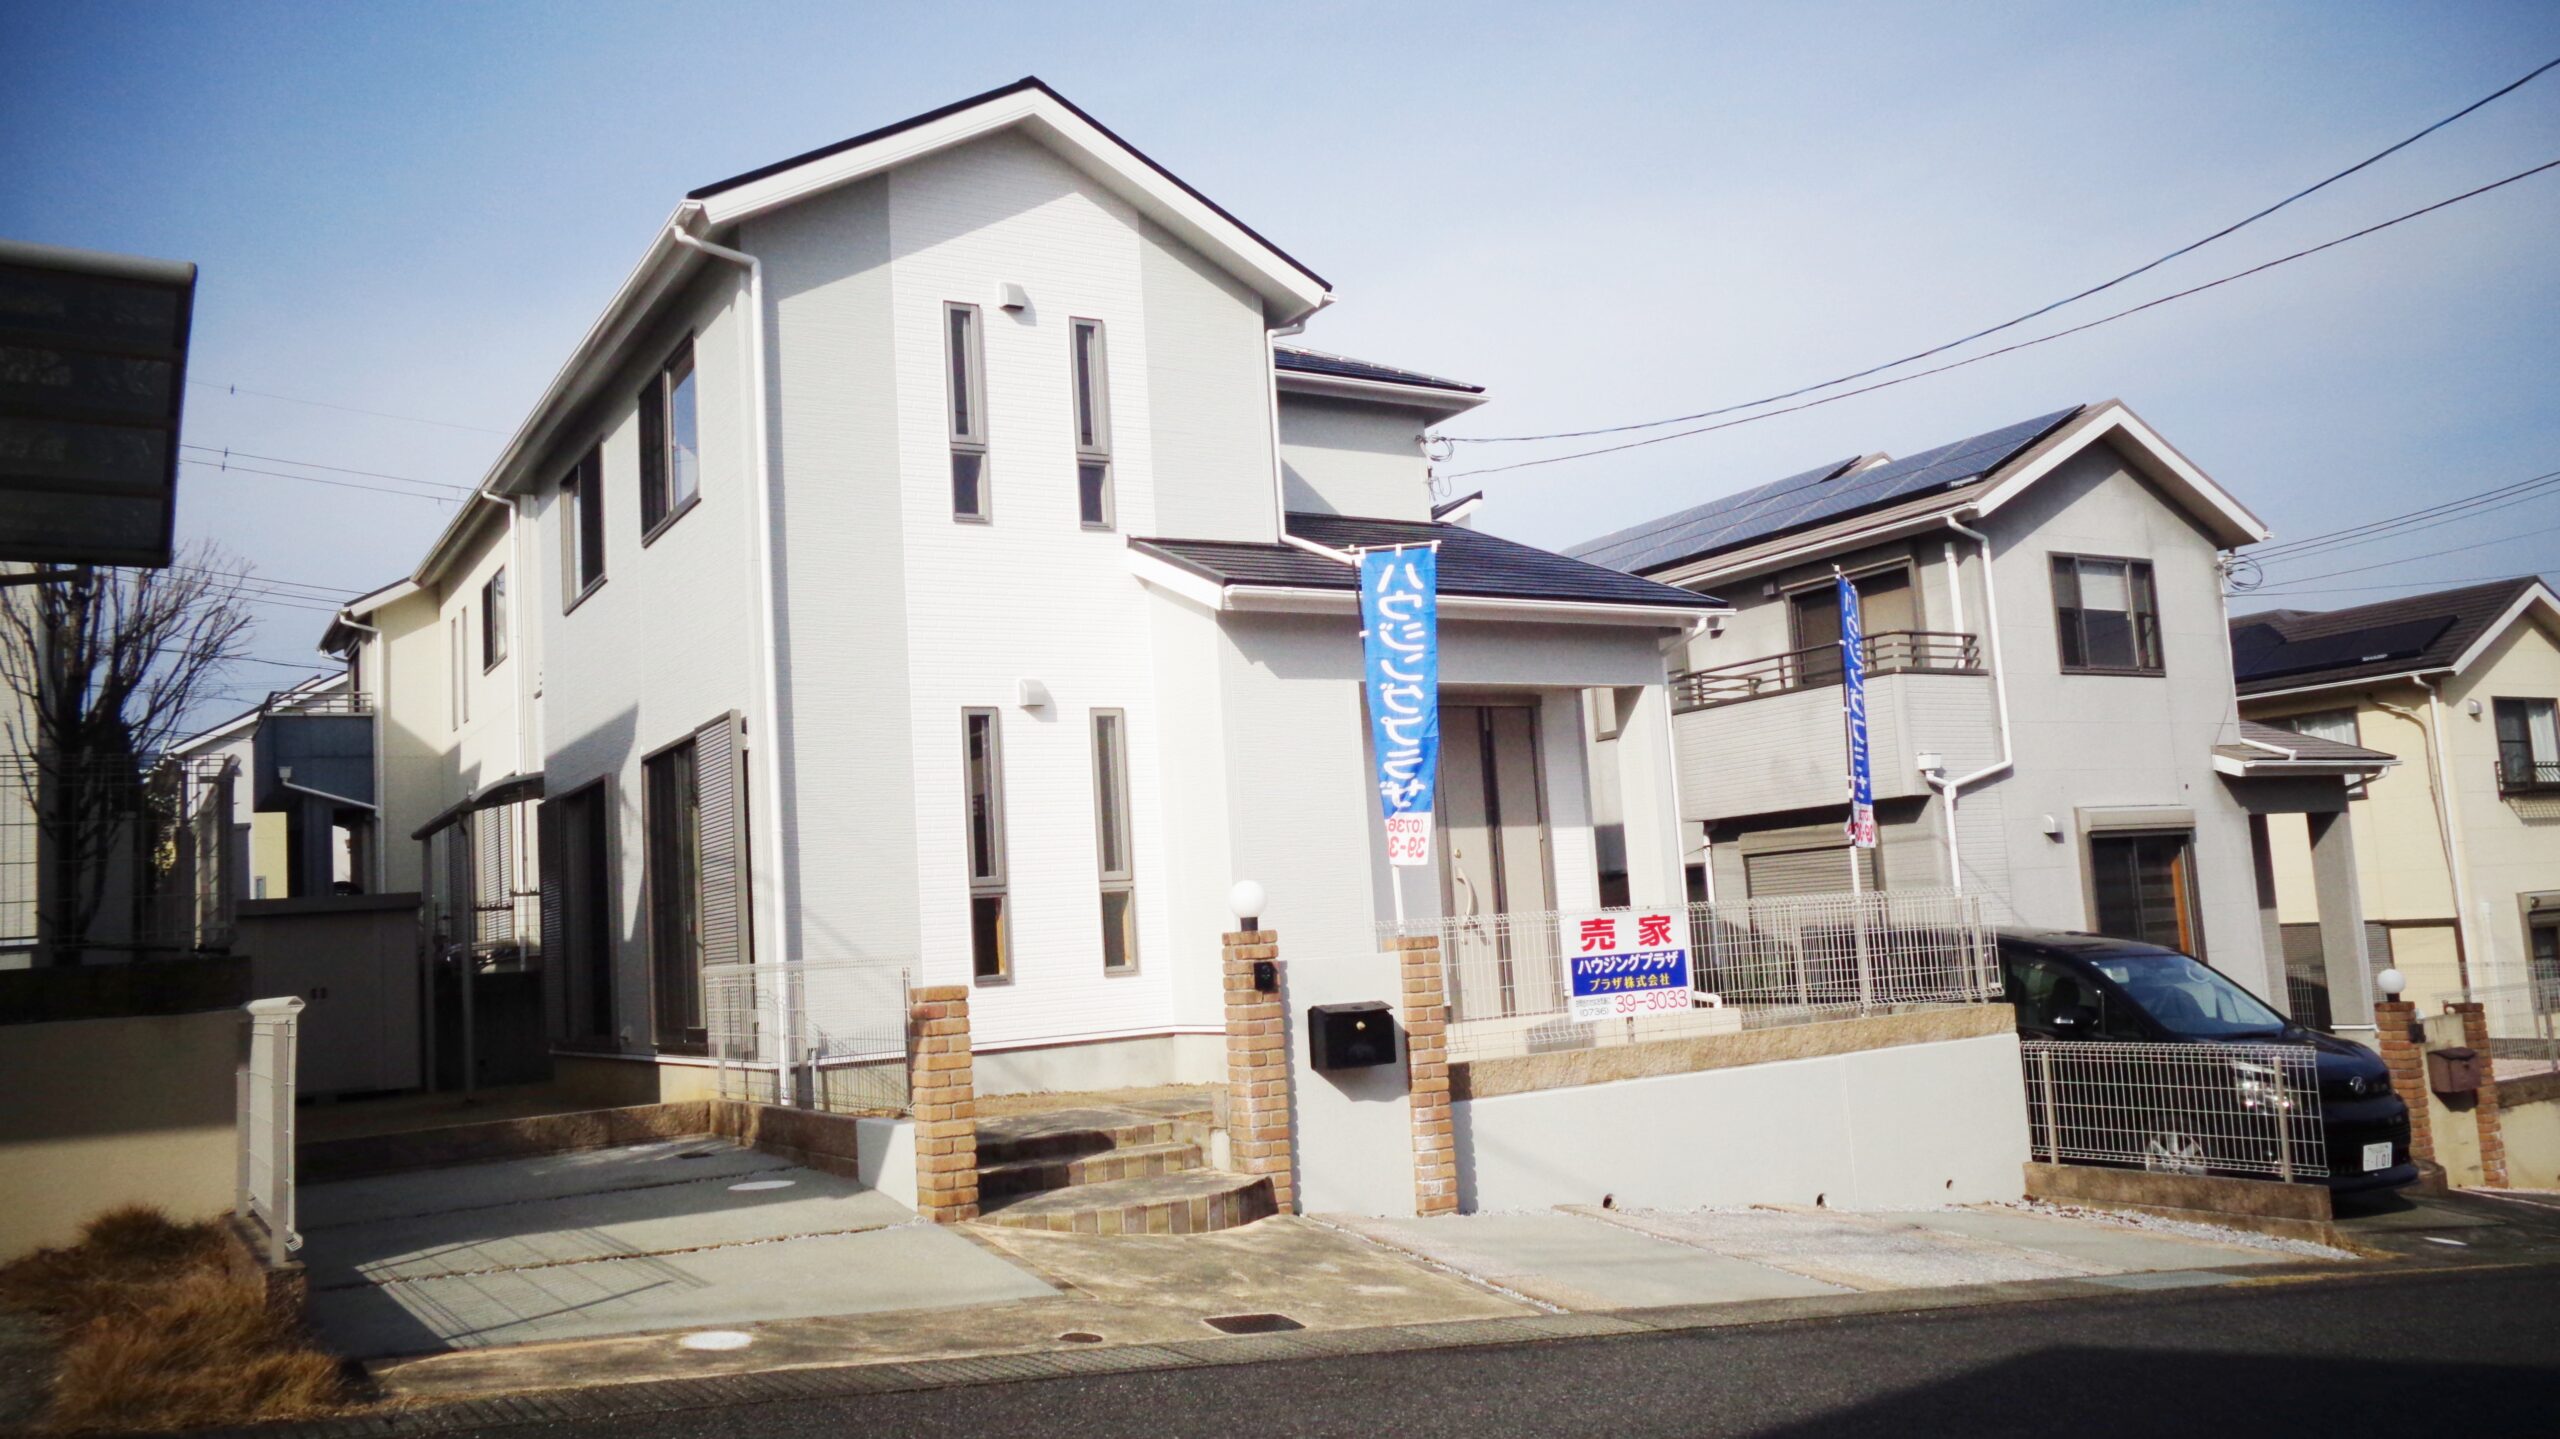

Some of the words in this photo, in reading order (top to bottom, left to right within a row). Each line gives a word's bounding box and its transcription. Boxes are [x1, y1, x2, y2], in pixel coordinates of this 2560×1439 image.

[1577, 951, 1679, 975] ハウジングプラザ
[1590, 973, 1671, 992] プラザ株式会社
[1615, 989, 1688, 1014] 39-3033
